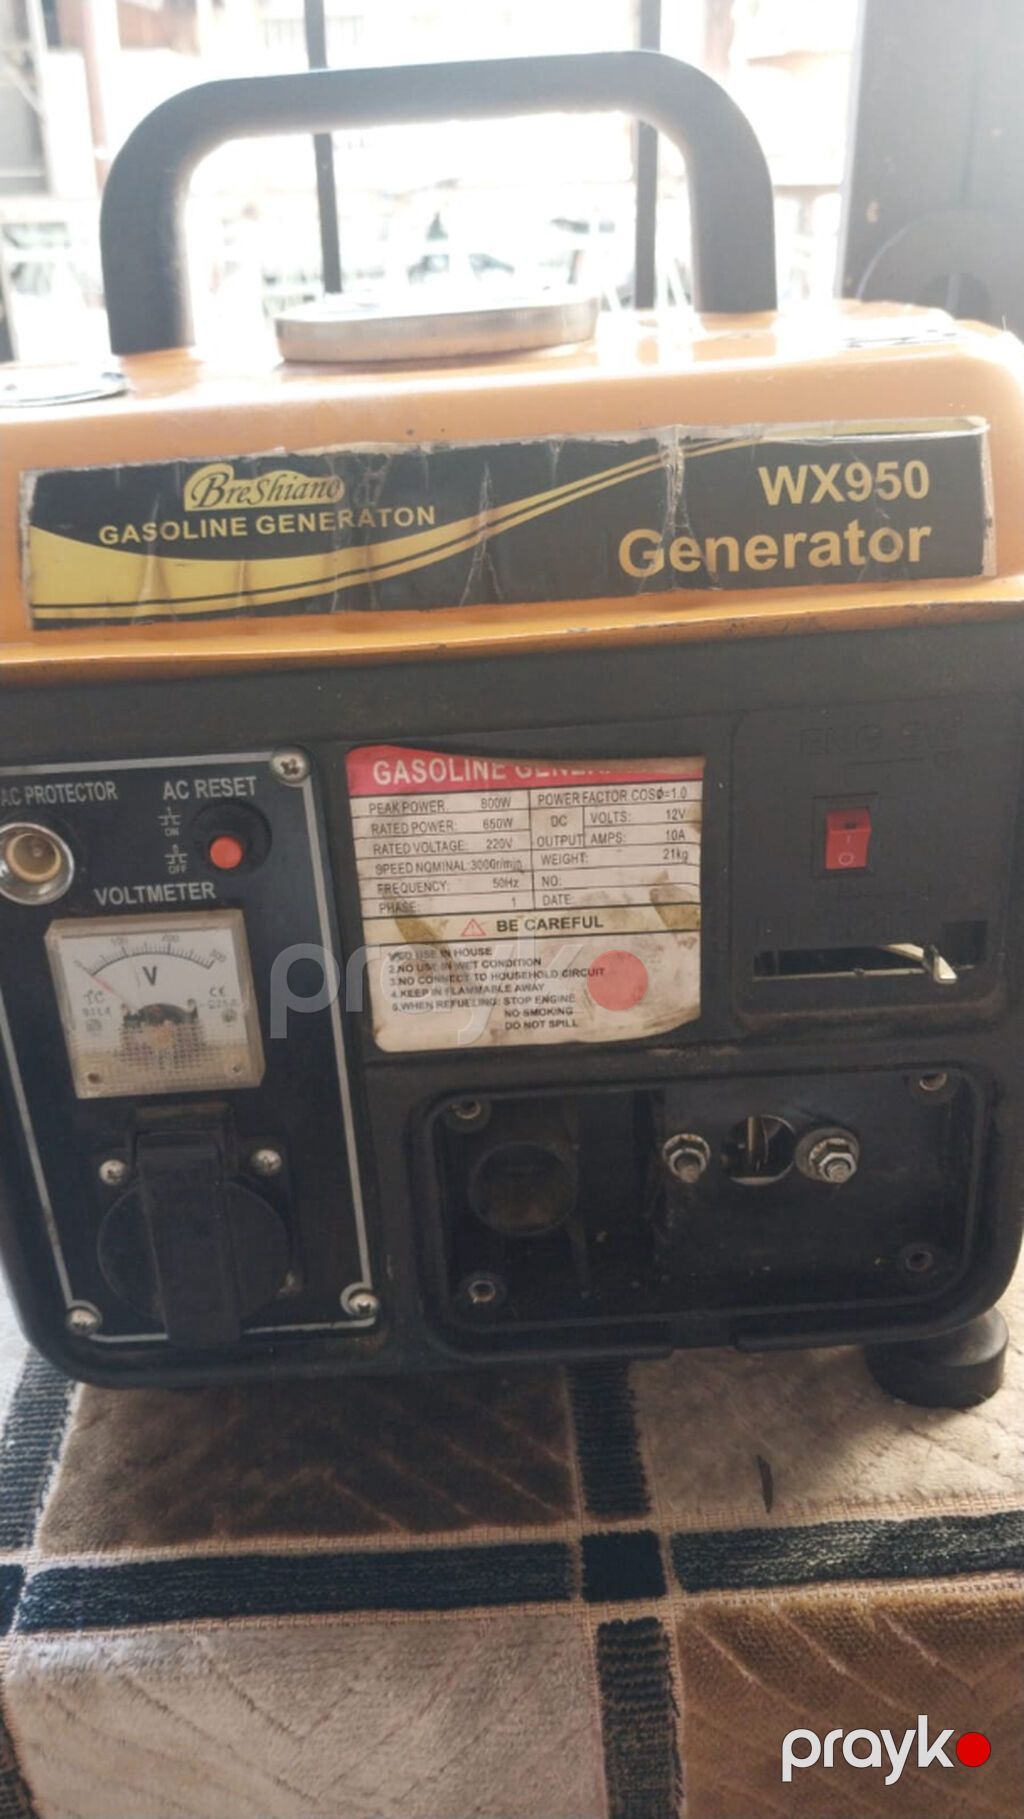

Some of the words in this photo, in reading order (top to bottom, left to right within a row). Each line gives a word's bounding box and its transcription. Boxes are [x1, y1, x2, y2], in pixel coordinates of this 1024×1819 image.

[759, 460, 930, 506] WX950
[99, 517, 248, 545] GASOLINE
[255, 506, 436, 535] GENERATON
[618, 519, 932, 578] Generator
[373, 758, 506, 785] GASOLINE
[24, 781, 118, 805] PROTECTOR
[163, 781, 189, 800] AC
[195, 776, 257, 798] RESET
[538, 793, 583, 806] POWER
[368, 802, 400, 815] PEAK
[666, 808, 687, 821] 12V
[483, 817, 514, 830] 650W
[551, 815, 568, 827] DC
[590, 811, 631, 825] VOLTS:
[164, 828, 180, 837] ON
[371, 822, 409, 835] RATED
[666, 829, 686, 842] 10A
[486, 837, 513, 850] 220V
[537, 833, 583, 847] OUTPUT
[590, 831, 626, 845] AMPS:
[373, 842, 411, 856] RATED
[663, 848, 689, 863] 21kg
[541, 852, 588, 866] WEIGHT:
[375, 862, 413, 876] SPEED
[492, 876, 519, 889] 50Hz
[94, 882, 216, 906] VOLTMETER
[496, 919, 519, 933] BE
[524, 915, 604, 931] CAREFUL
[453, 946, 493, 957] HOUSE
[481, 957, 542, 969] CONDITION
[142, 965, 158, 986] V
[473, 972, 487, 982] TO
[491, 969, 558, 981] HOUSEHOLD
[562, 967, 605, 978] CIRCUIT
[514, 983, 545, 993] AWAY
[504, 996, 532, 1007] STOP
[535, 993, 577, 1005] ENGINE
[504, 1008, 520, 1018] NO
[523, 1006, 574, 1018] SMOKING
[505, 1019, 521, 1030] DO
[524, 1018, 546, 1029] NOT
[549, 1017, 579, 1028] SPILL
